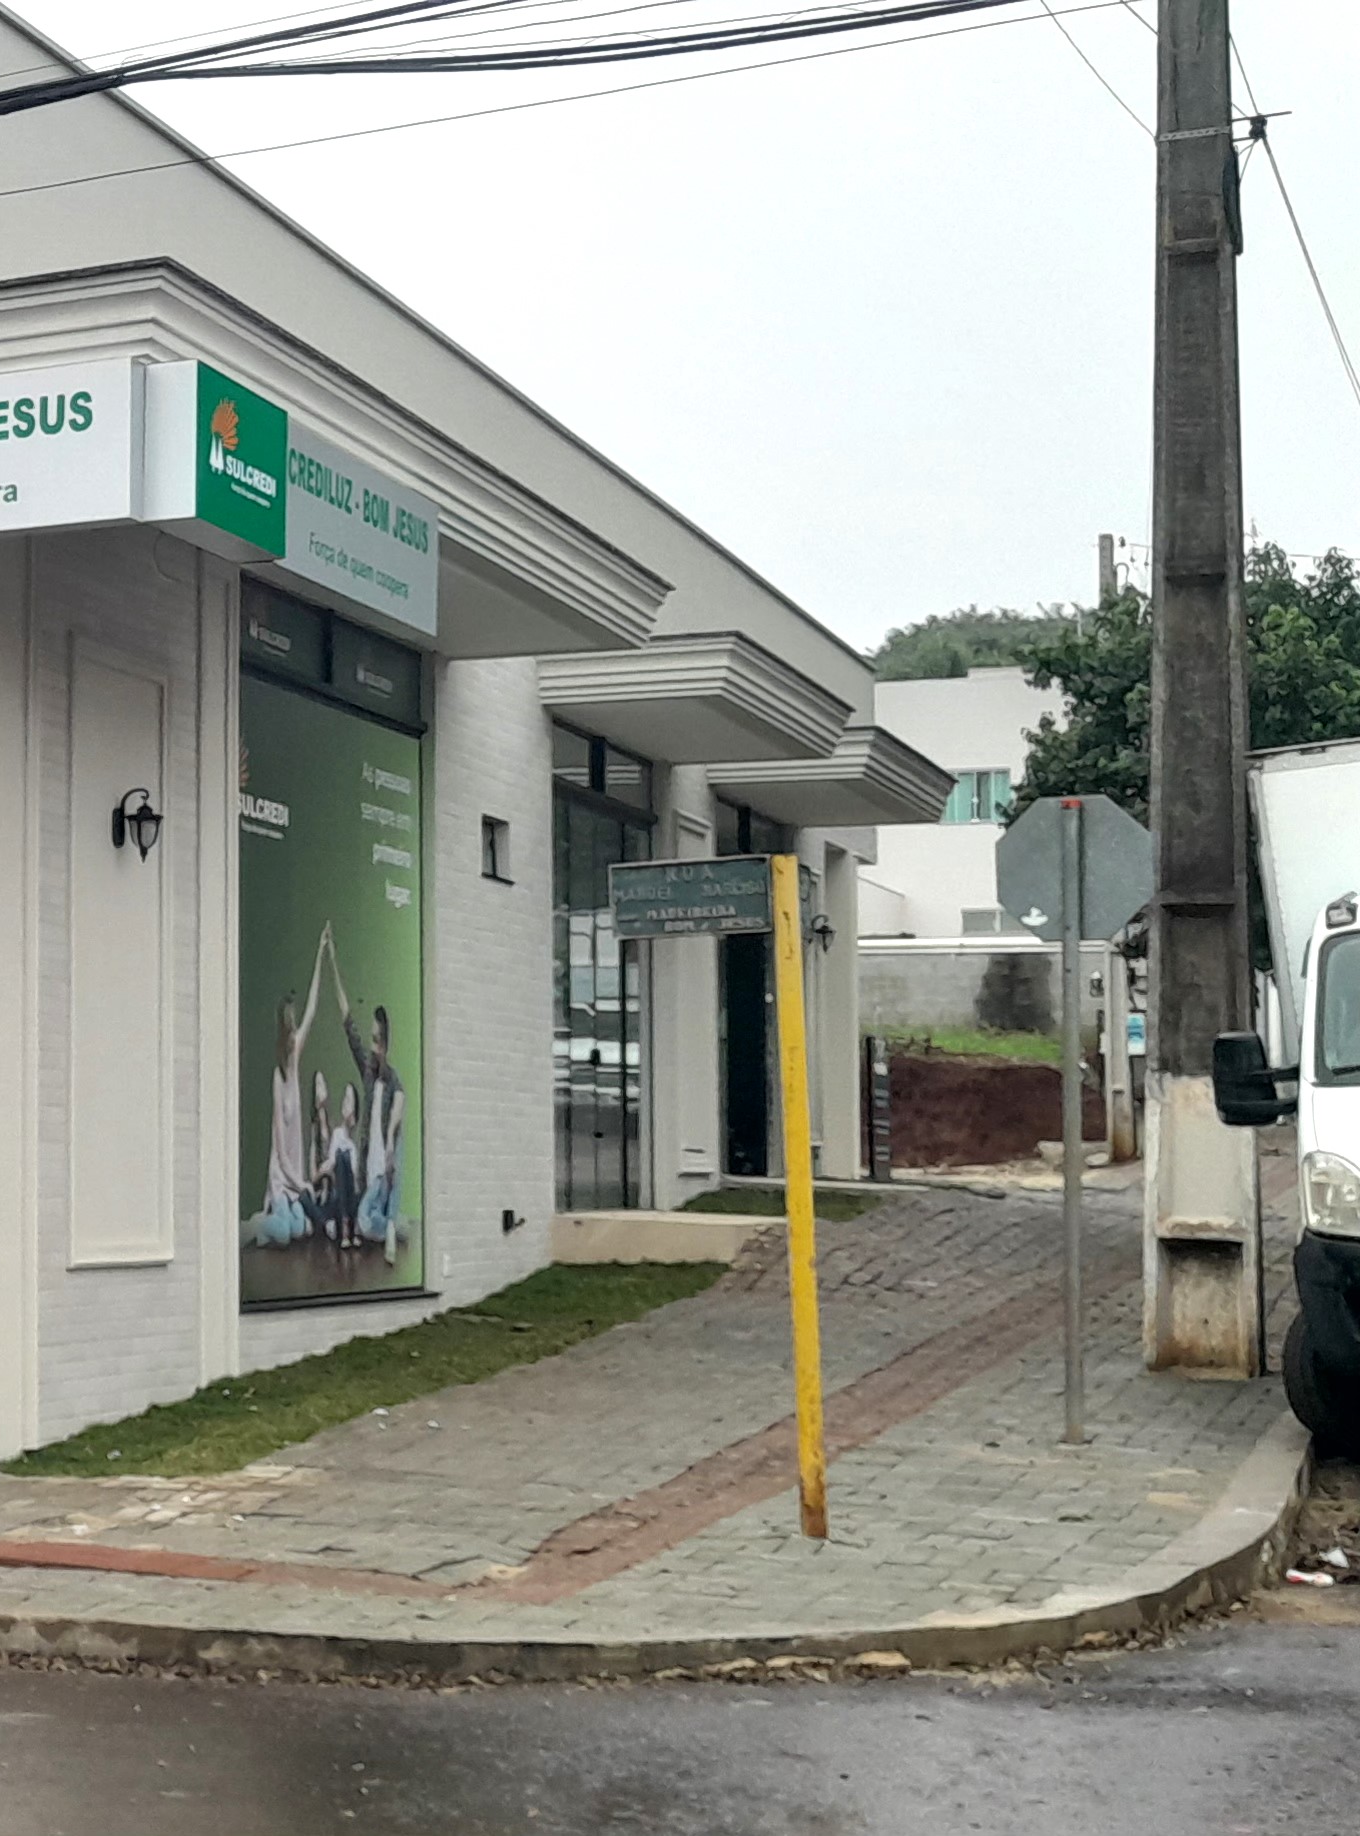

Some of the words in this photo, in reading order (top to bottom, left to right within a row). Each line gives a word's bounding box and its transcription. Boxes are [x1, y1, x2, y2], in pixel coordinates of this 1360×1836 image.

[226, 455, 277, 498] SULCREDI
[288, 448, 353, 515] CREDILUZ
[363, 488, 391, 534] BOM
[393, 505, 429, 554] JESUS
[308, 531, 336, 567] Força
